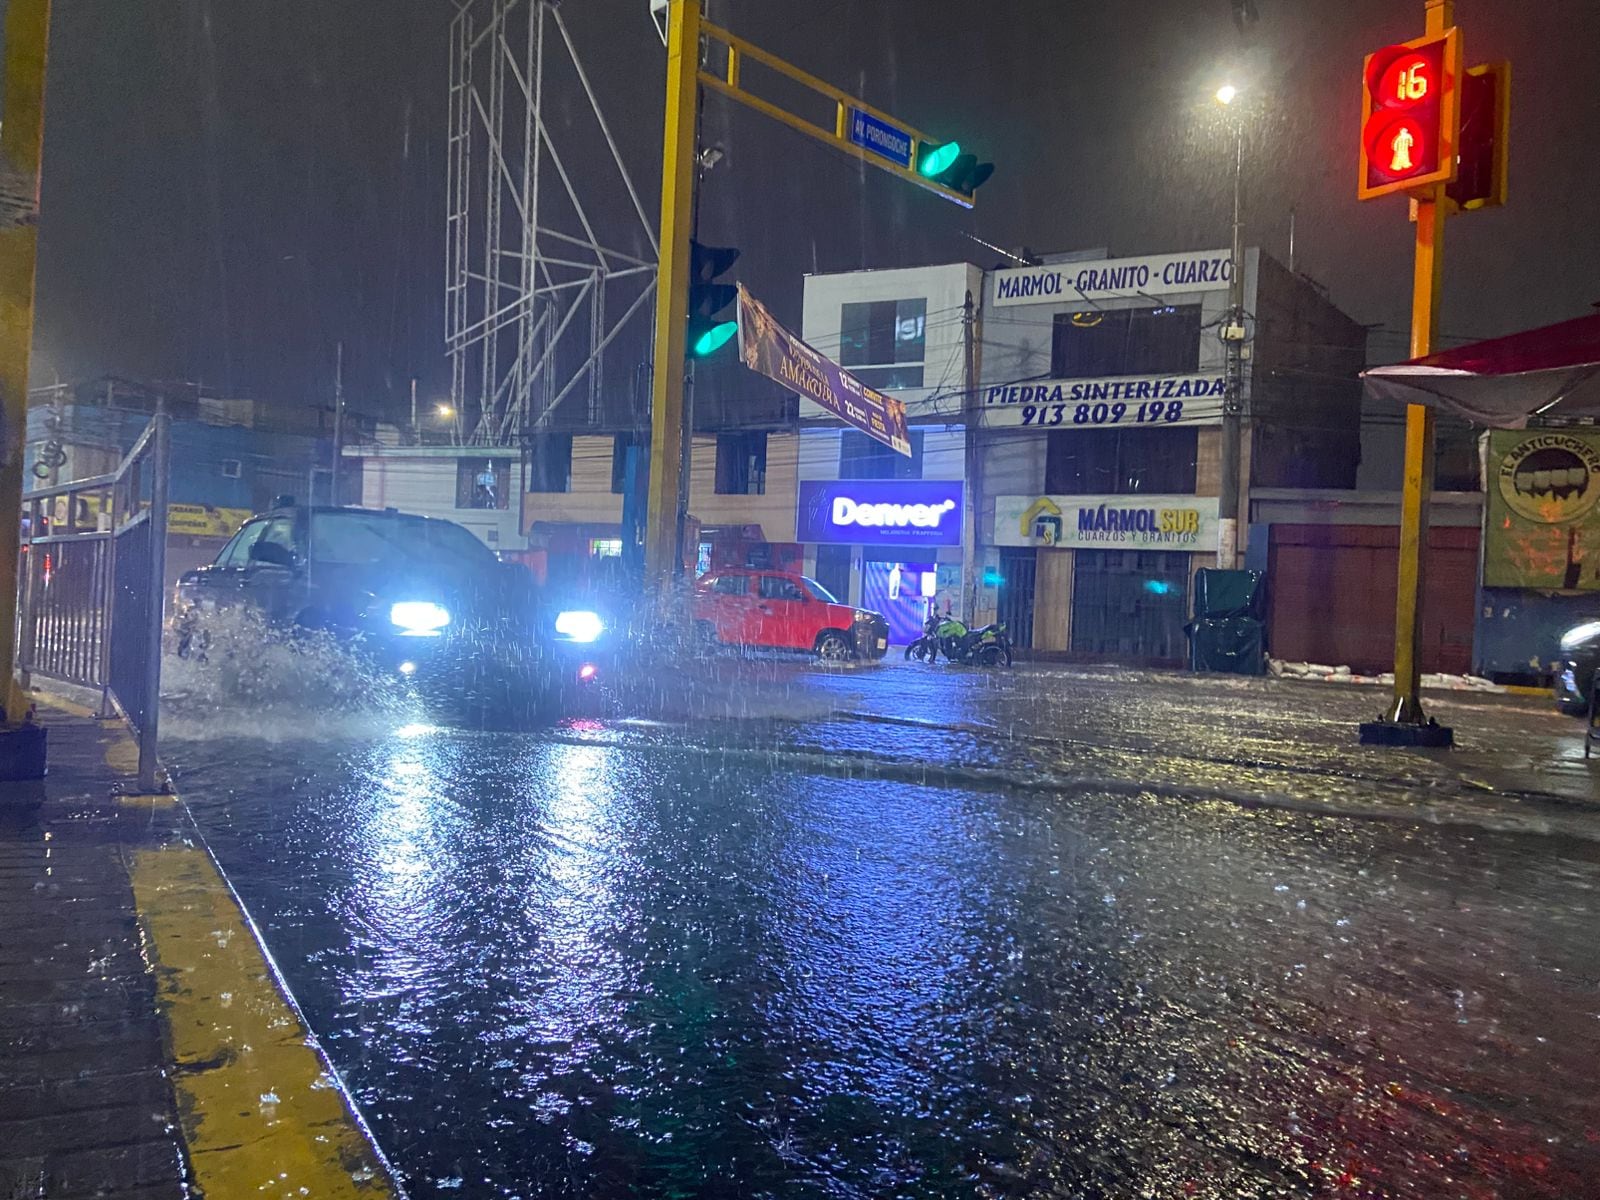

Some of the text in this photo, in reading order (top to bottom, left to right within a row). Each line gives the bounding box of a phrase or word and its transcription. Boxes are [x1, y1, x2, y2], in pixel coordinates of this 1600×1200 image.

[1397, 62, 1427, 100] 16
[998, 258, 1231, 299] MARMOL GRANITO CUARZO
[988, 378, 1225, 404] PIEDRA SINTERIZADA
[1022, 400, 1183, 426] 913 809 198
[832, 496, 956, 528] Denver
[1078, 531, 1197, 543] CUARZOS Y GRANITOS
